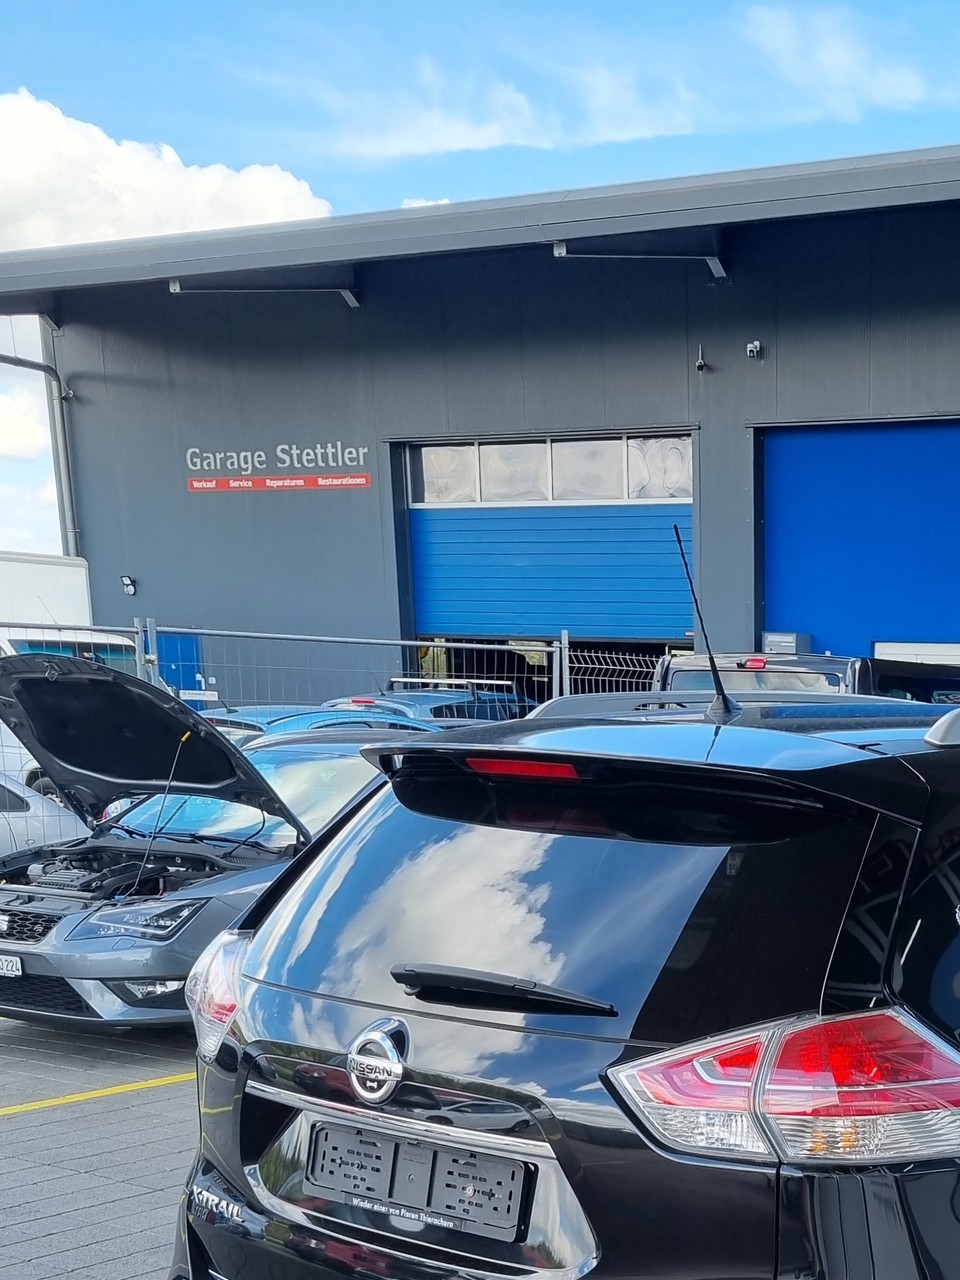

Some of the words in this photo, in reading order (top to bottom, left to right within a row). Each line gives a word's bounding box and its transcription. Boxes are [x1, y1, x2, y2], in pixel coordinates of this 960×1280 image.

[186, 447, 267, 475] Garage
[276, 441, 368, 468] Stettler
[192, 480, 216, 488] Verkauf
[229, 479, 252, 488] Service
[266, 479, 304, 487] Reparaturen
[318, 477, 366, 486] Restaurationen
[350, 1058, 392, 1077] NISSAN
[191, 1185, 243, 1222] X-TRAIL
[352, 1197, 373, 1209] Wieder
